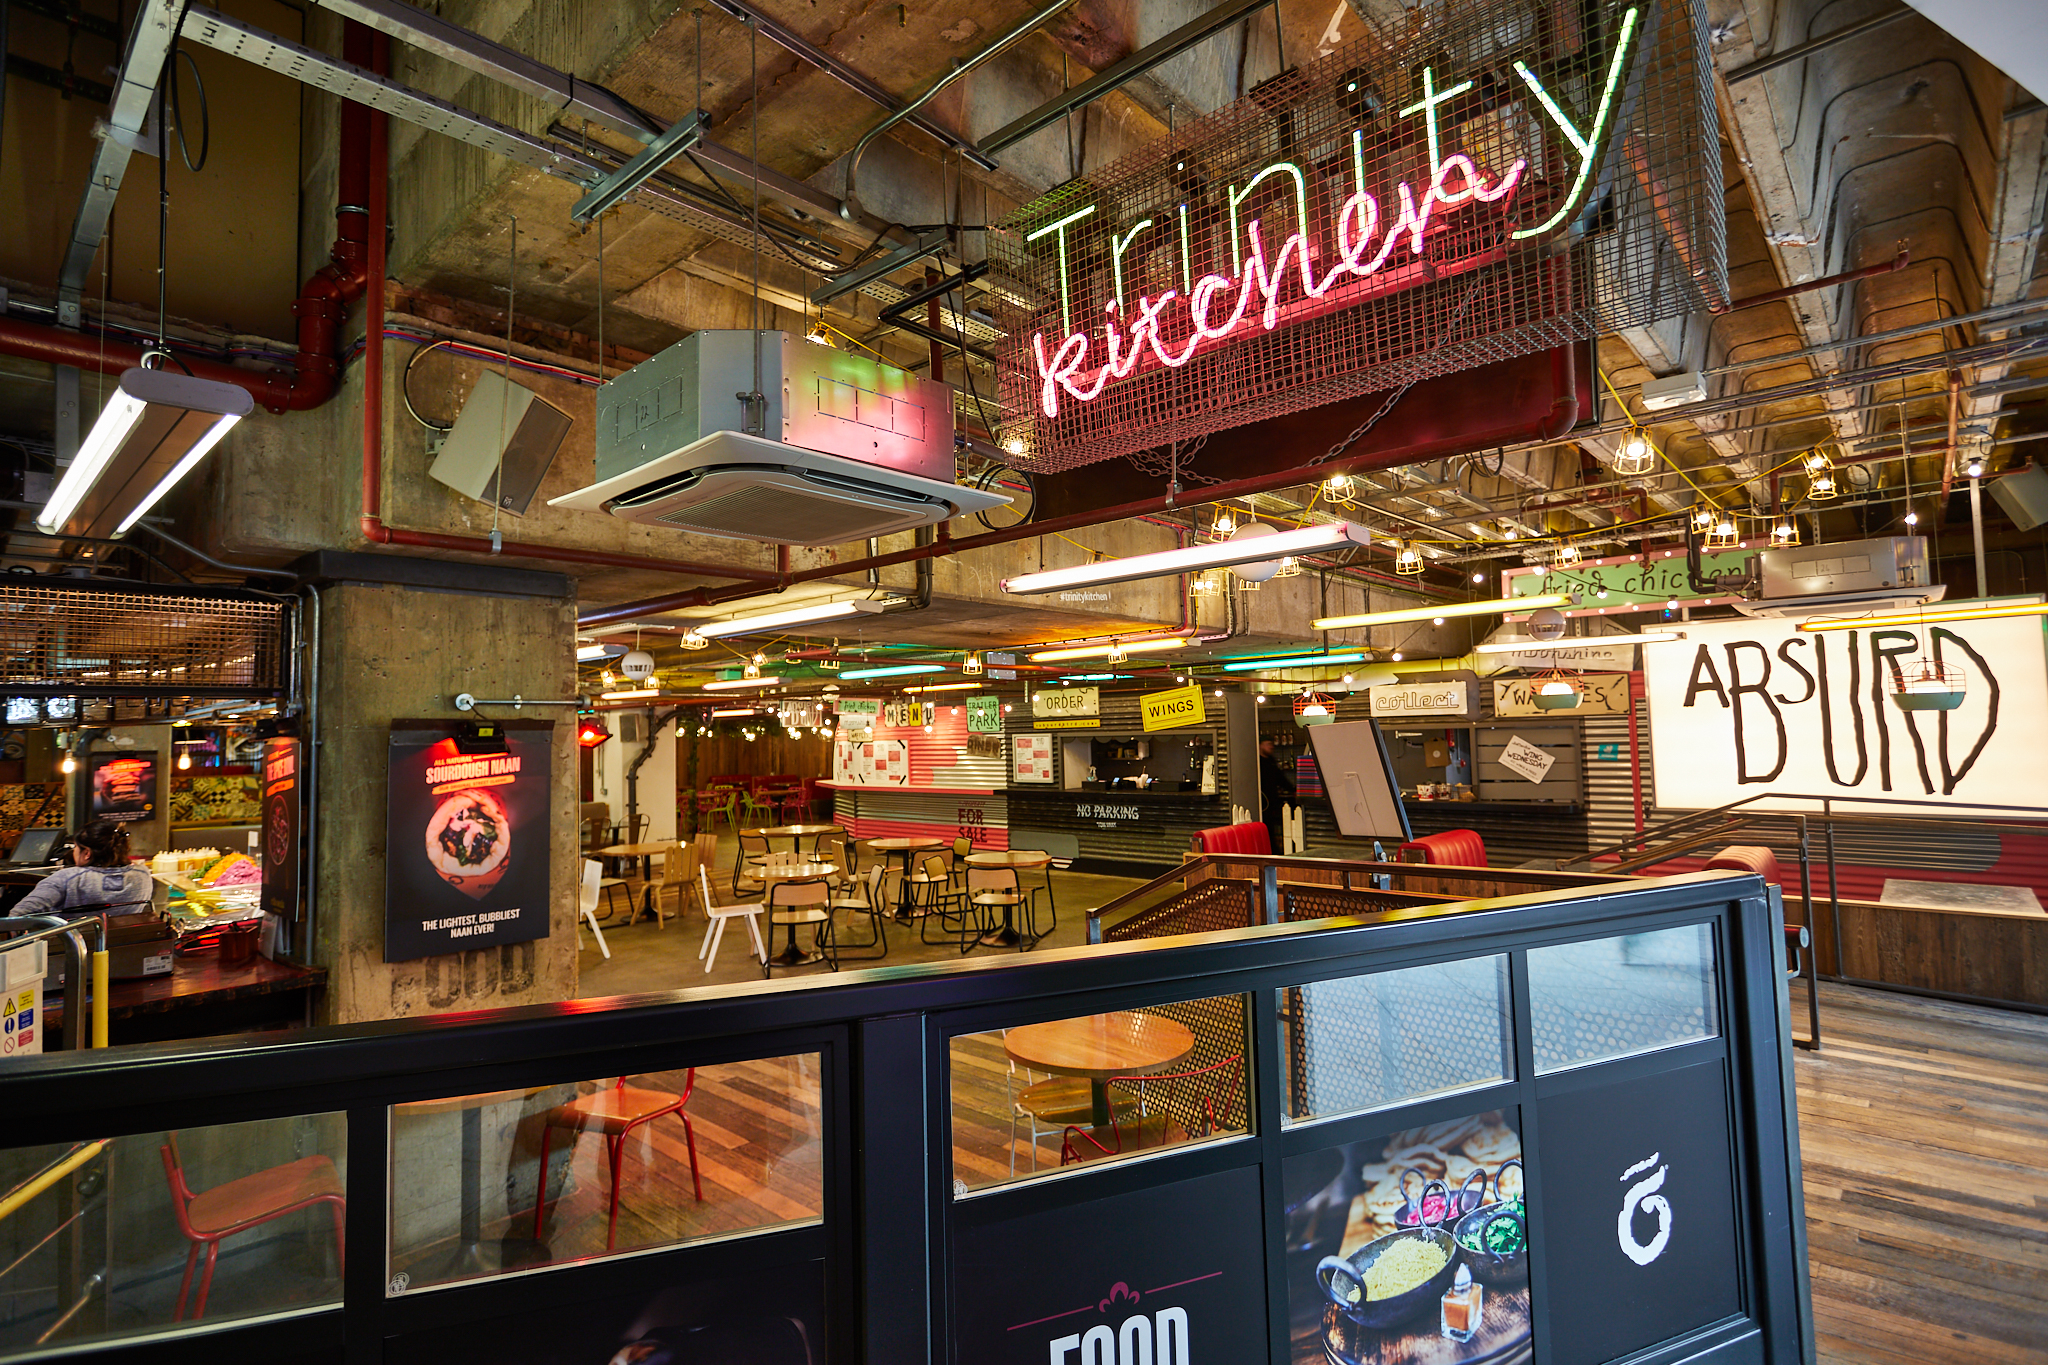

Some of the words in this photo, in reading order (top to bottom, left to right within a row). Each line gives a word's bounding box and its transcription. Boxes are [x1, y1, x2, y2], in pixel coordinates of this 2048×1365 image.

[1026, 7, 1640, 338] Trinity
[1538, 570, 1604, 597] fried
[1624, 564, 1741, 594] chicen
[968, 700, 997, 710] TRAILER
[1046, 695, 1084, 710] ORDER
[1148, 699, 1194, 718] WINGS
[1375, 691, 1460, 711] collect
[887, 708, 932, 724] MENU
[969, 713, 998, 728] PARK
[1683, 627, 2000, 796] ABSURD
[1506, 750, 1548, 770] WEDNESDAY
[1523, 749, 1543, 761] WING
[425, 760, 490, 784] SOURDOUGH
[490, 756, 521, 775] NAAN
[958, 808, 984, 826] FOR
[1076, 804, 1091, 818] NO
[1093, 804, 1140, 820] PARKING
[958, 826, 988, 843] SALE
[422, 920, 438, 931] THE
[479, 908, 521, 924] BUBBLIEST
[450, 926, 473, 938] NAAN
[474, 923, 495, 936] EVER!
